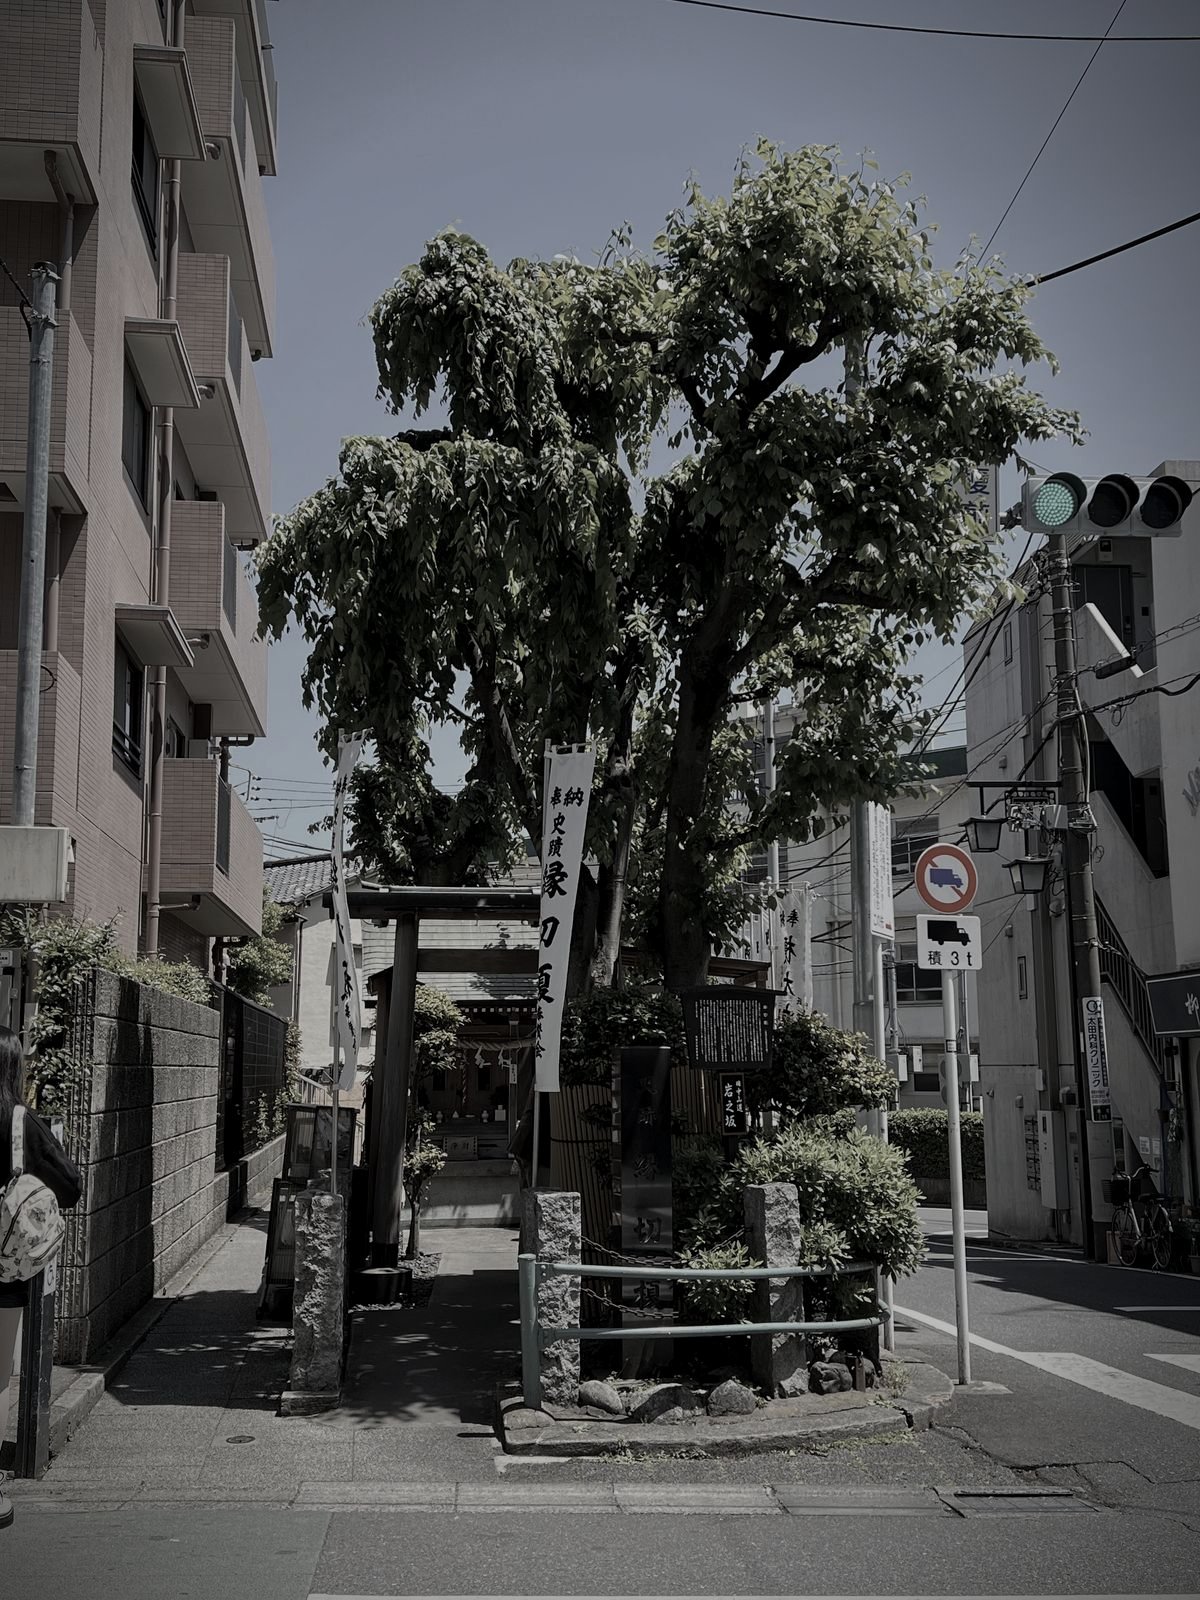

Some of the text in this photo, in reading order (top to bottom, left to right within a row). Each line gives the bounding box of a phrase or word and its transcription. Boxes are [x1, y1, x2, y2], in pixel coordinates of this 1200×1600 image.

[550, 786, 584, 809] 奉納
[724, 1082, 737, 1127] 岩之坂
